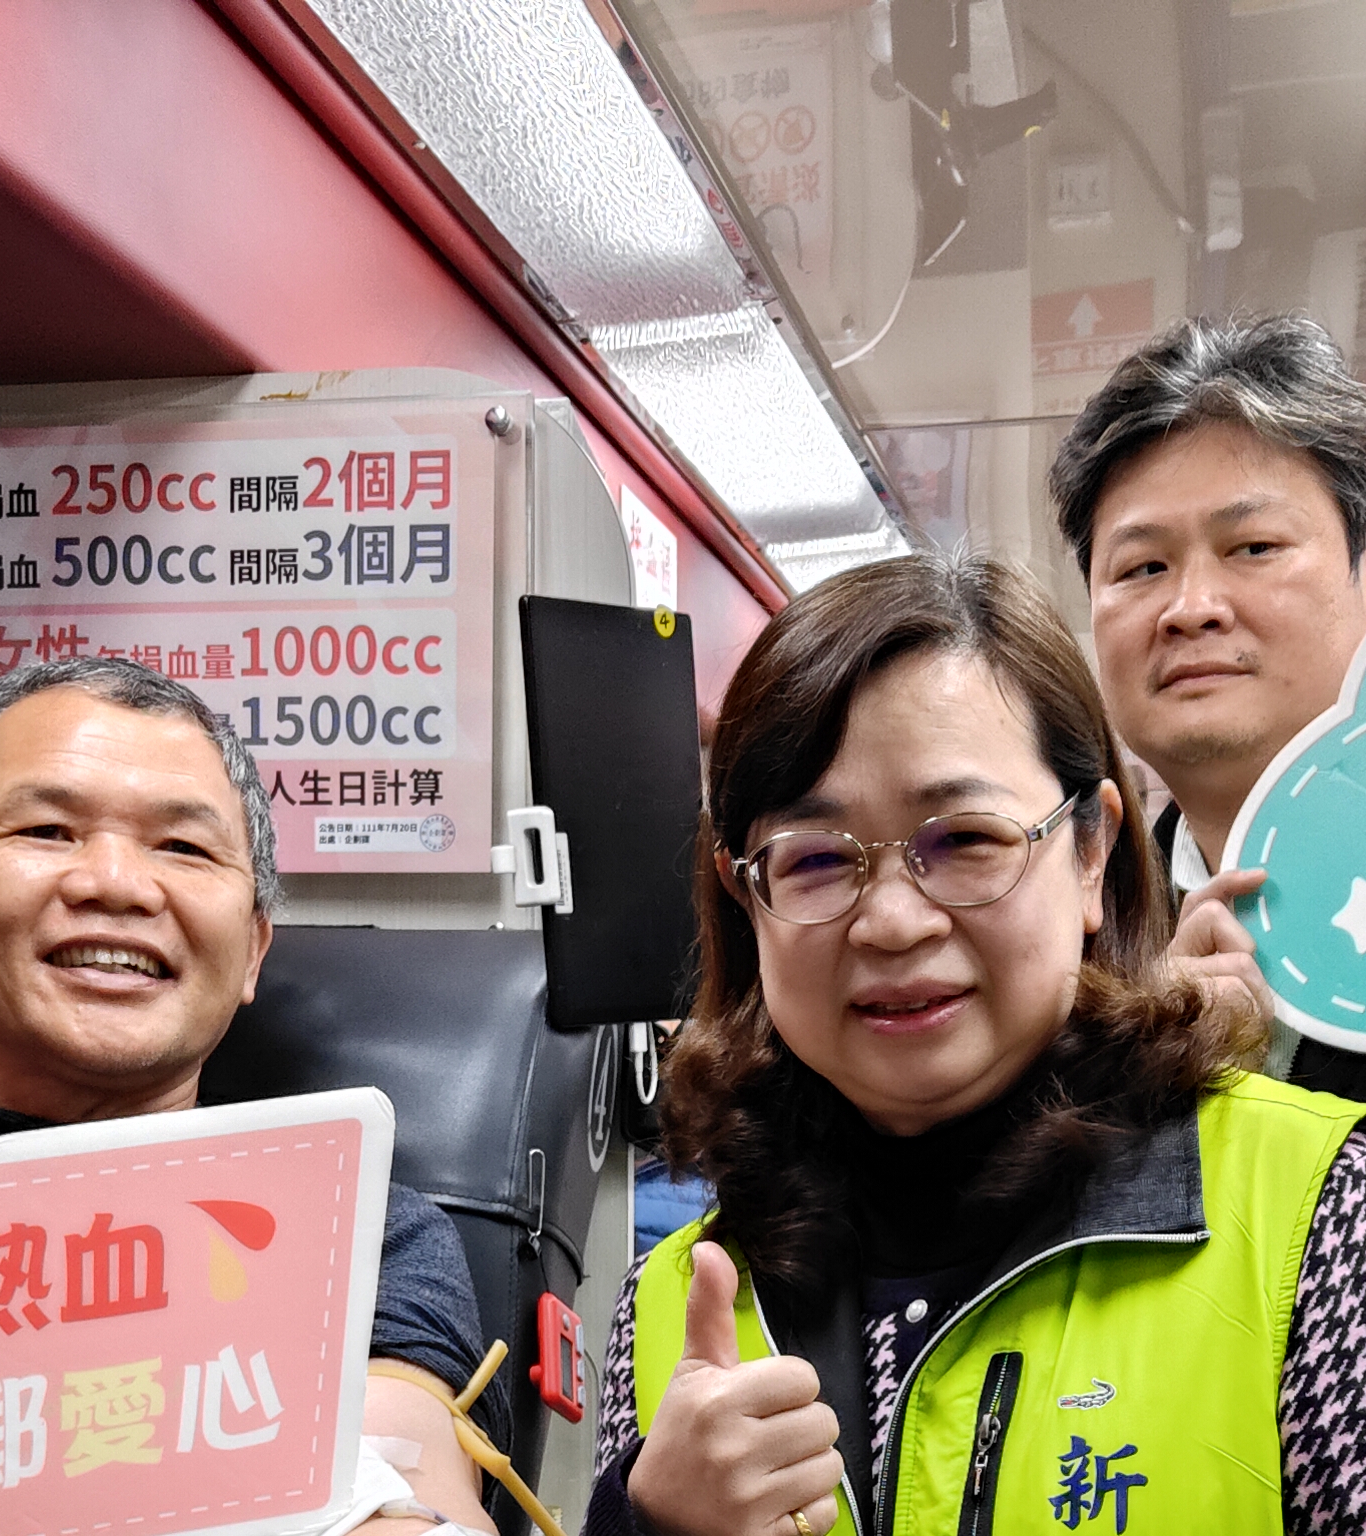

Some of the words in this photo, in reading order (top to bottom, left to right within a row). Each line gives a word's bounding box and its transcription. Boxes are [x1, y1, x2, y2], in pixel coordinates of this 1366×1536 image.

[51, 462, 217, 515] 250cc
[229, 450, 451, 513] 間隔2個月
[52, 534, 217, 587] 500cc
[229, 523, 451, 586] 間隔3個月
[659, 612, 670, 629] 4
[271, 768, 444, 806] 人生日計算
